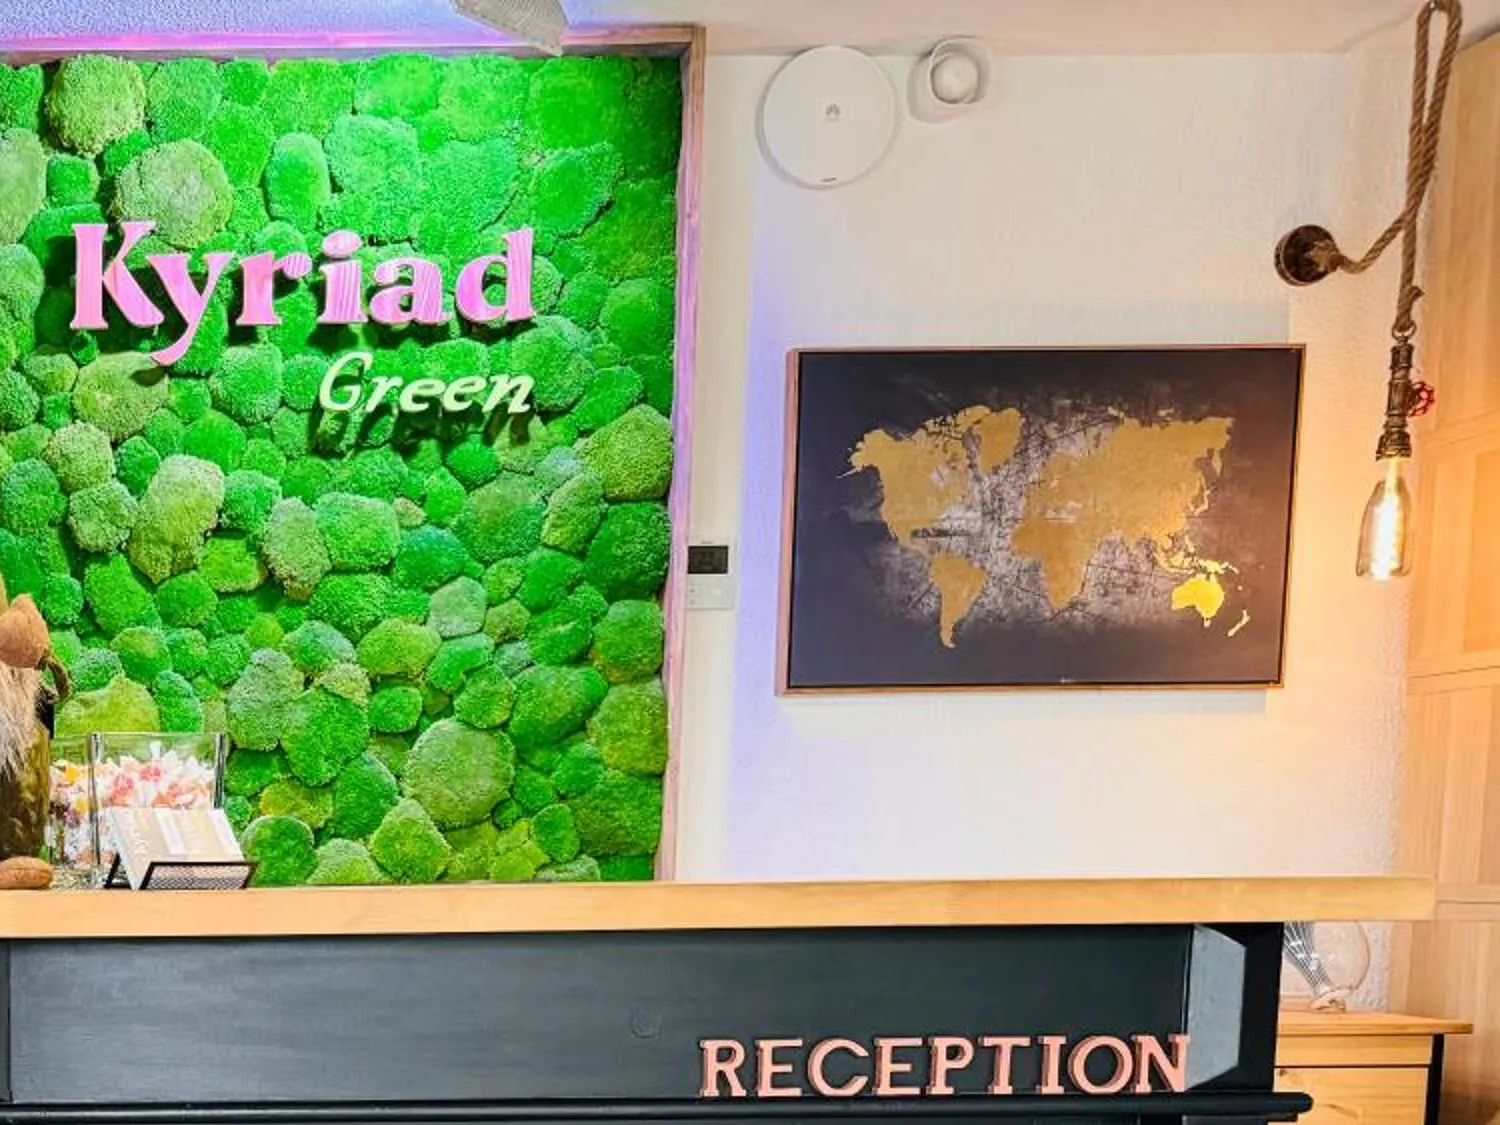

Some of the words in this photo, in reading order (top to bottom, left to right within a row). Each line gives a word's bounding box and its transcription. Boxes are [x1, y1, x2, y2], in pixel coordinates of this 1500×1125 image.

[69, 220, 534, 366] Kyriad
[318, 351, 535, 414] Green
[699, 1034, 1191, 1098] RECEPTION
